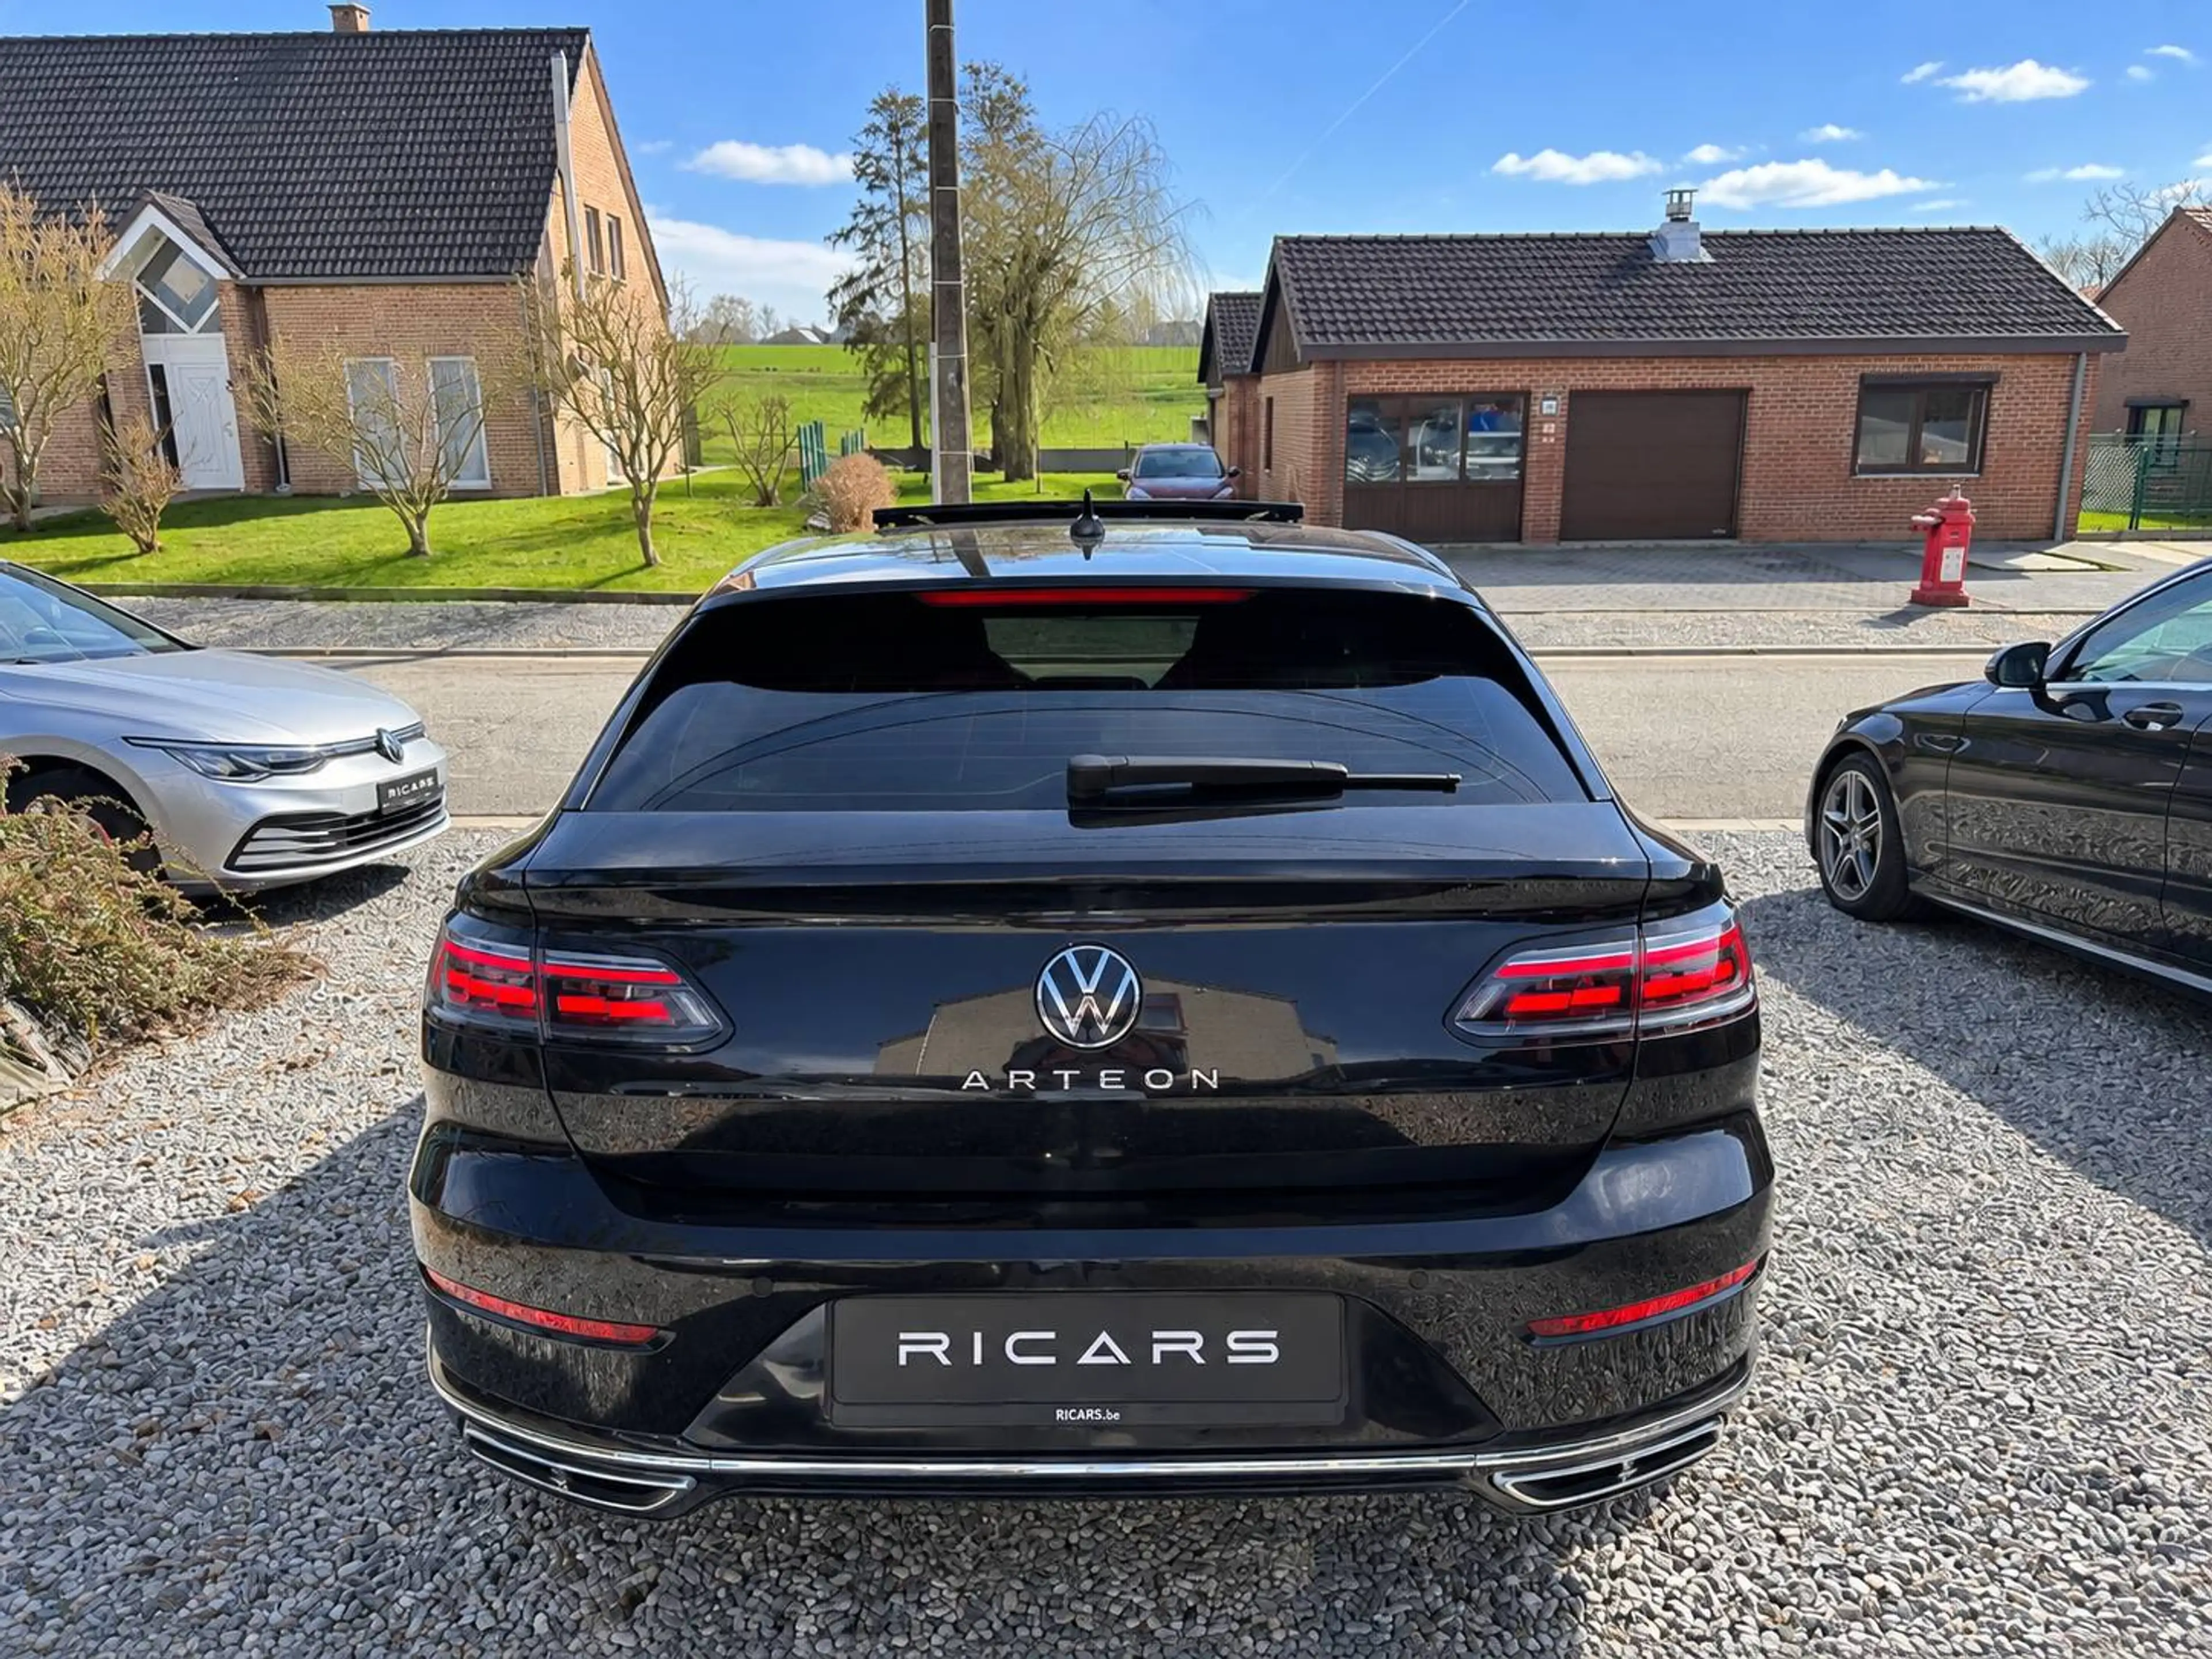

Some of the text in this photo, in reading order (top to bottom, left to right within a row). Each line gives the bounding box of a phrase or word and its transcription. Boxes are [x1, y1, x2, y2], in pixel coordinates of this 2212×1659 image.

[961, 1069, 1218, 1090] ARTEON
[897, 1330, 1280, 1366] RICARS
[1055, 1408, 1121, 1421] RICARS.be
